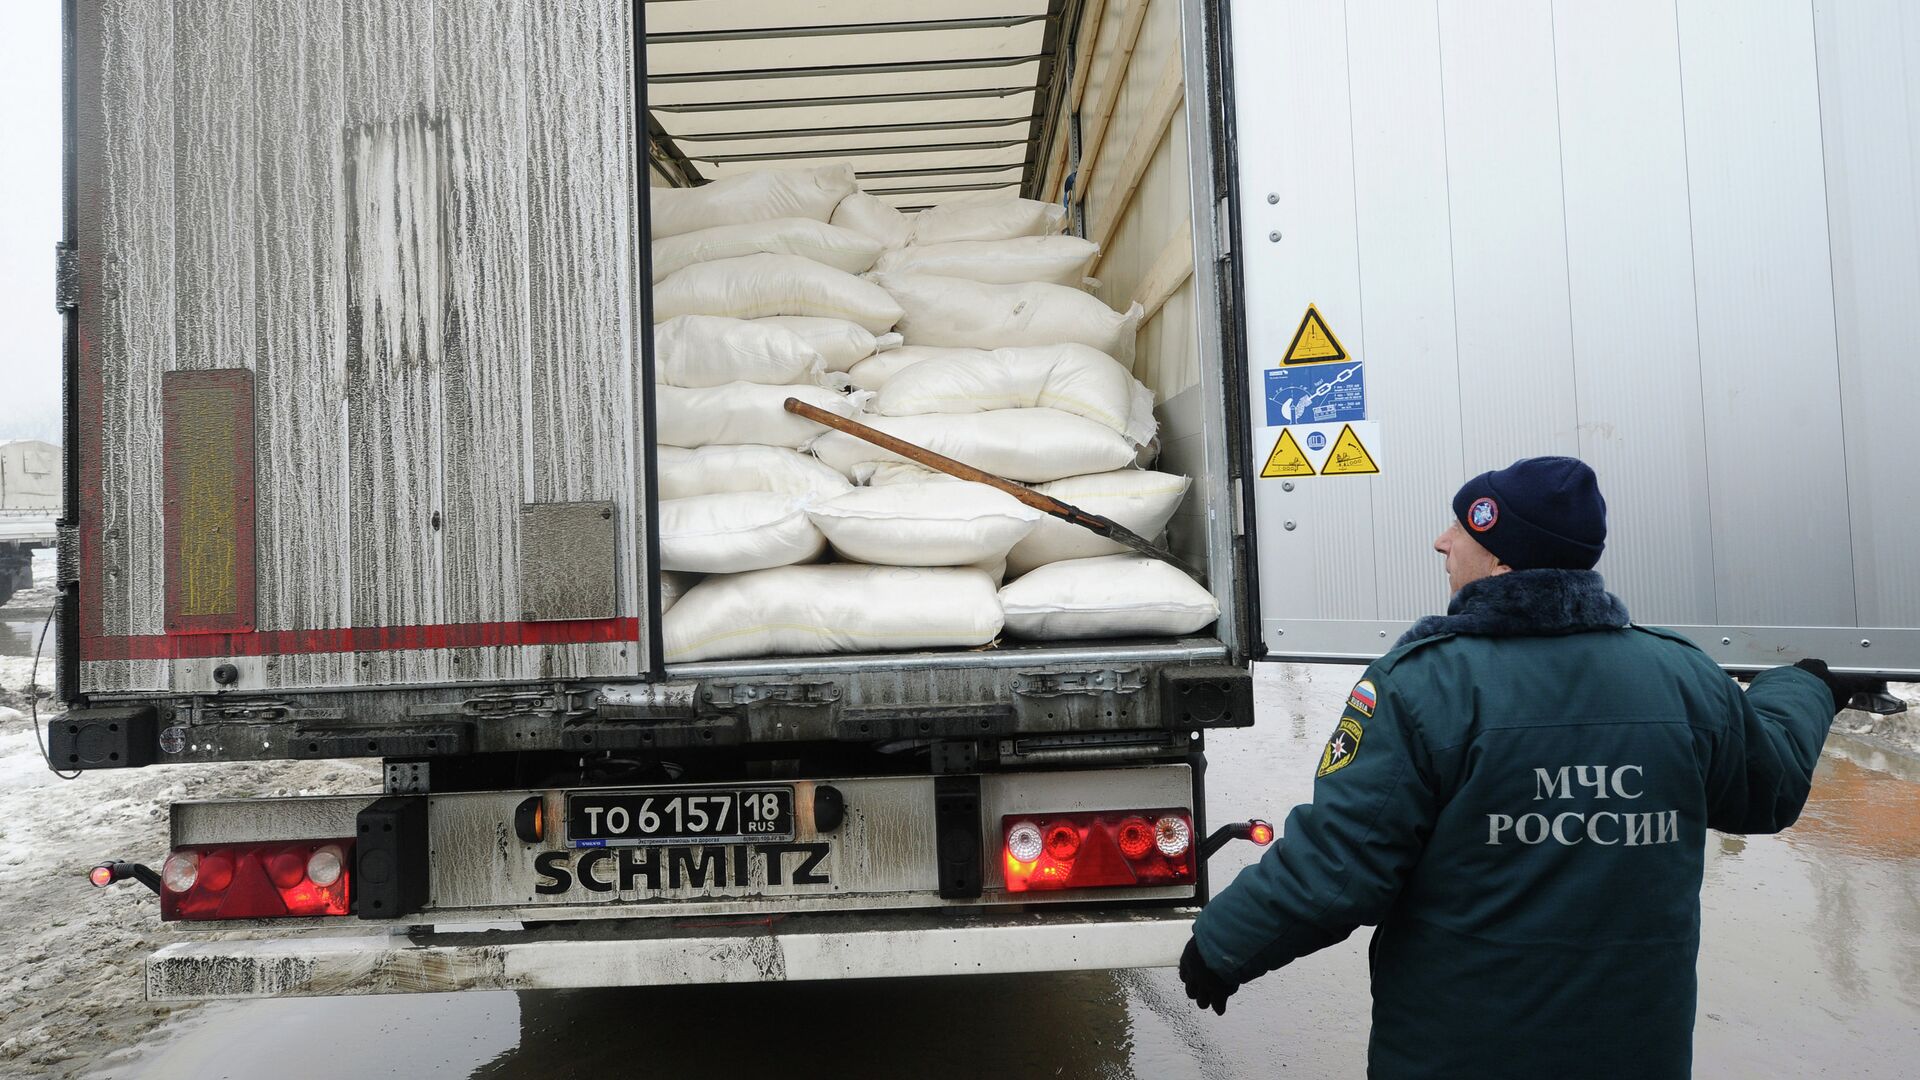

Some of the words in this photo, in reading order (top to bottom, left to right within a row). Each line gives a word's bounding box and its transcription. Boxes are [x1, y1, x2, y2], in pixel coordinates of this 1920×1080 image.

[1533, 764, 1644, 801] МЧС
[638, 797, 732, 834] 6157
[743, 793, 779, 822] 18
[748, 821, 775, 832] RUS
[1486, 809, 1680, 847] РОССИИ
[534, 843, 832, 895] SCHMITZ
